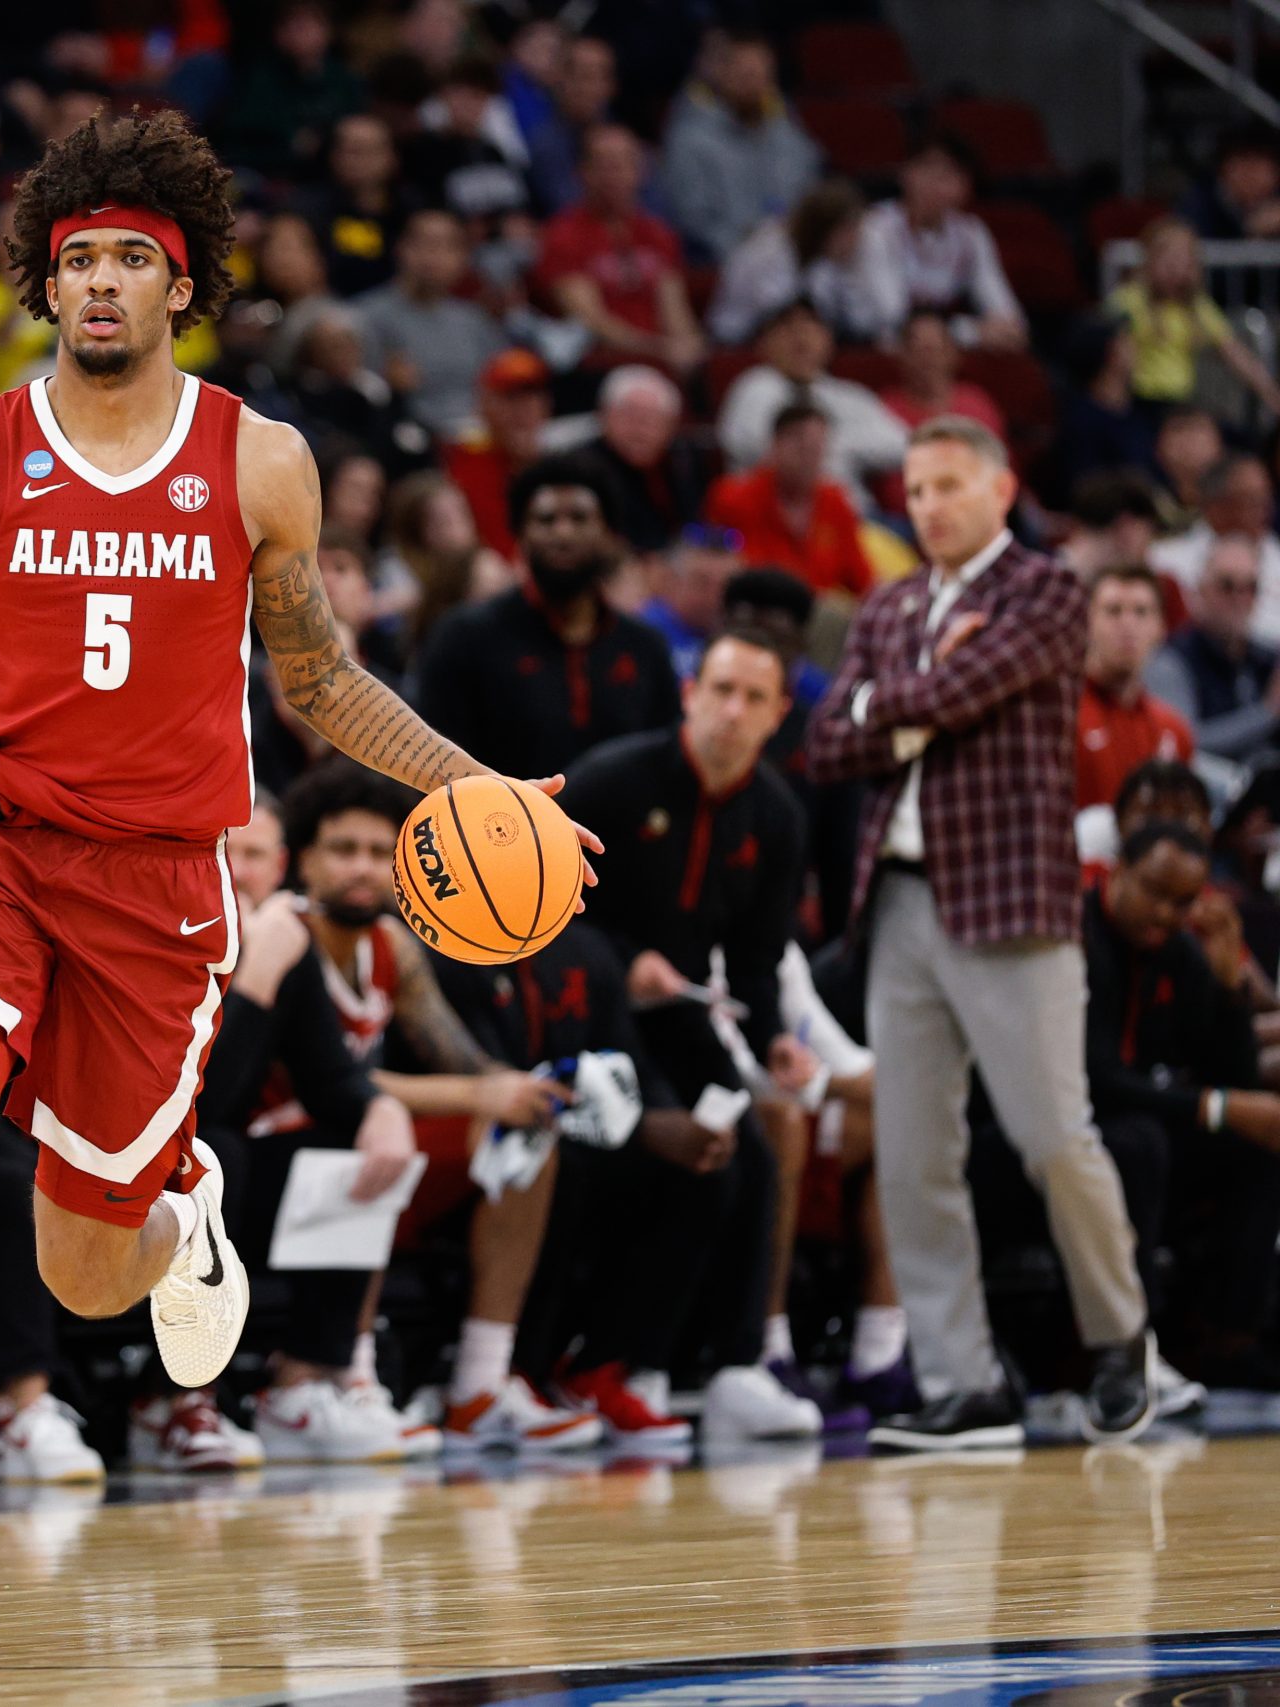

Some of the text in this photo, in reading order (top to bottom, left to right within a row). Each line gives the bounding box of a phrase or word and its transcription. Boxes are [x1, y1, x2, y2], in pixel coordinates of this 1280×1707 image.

[27, 462, 53, 472] NCAA
[172, 477, 206, 510] SEC
[9, 528, 216, 582] ALABAMA
[82, 592, 133, 691] 5
[413, 816, 460, 902] NCAA
[436, 832, 447, 856] GAME
[444, 854, 466, 894] OFFICIAL
[392, 850, 440, 947] Wilso
